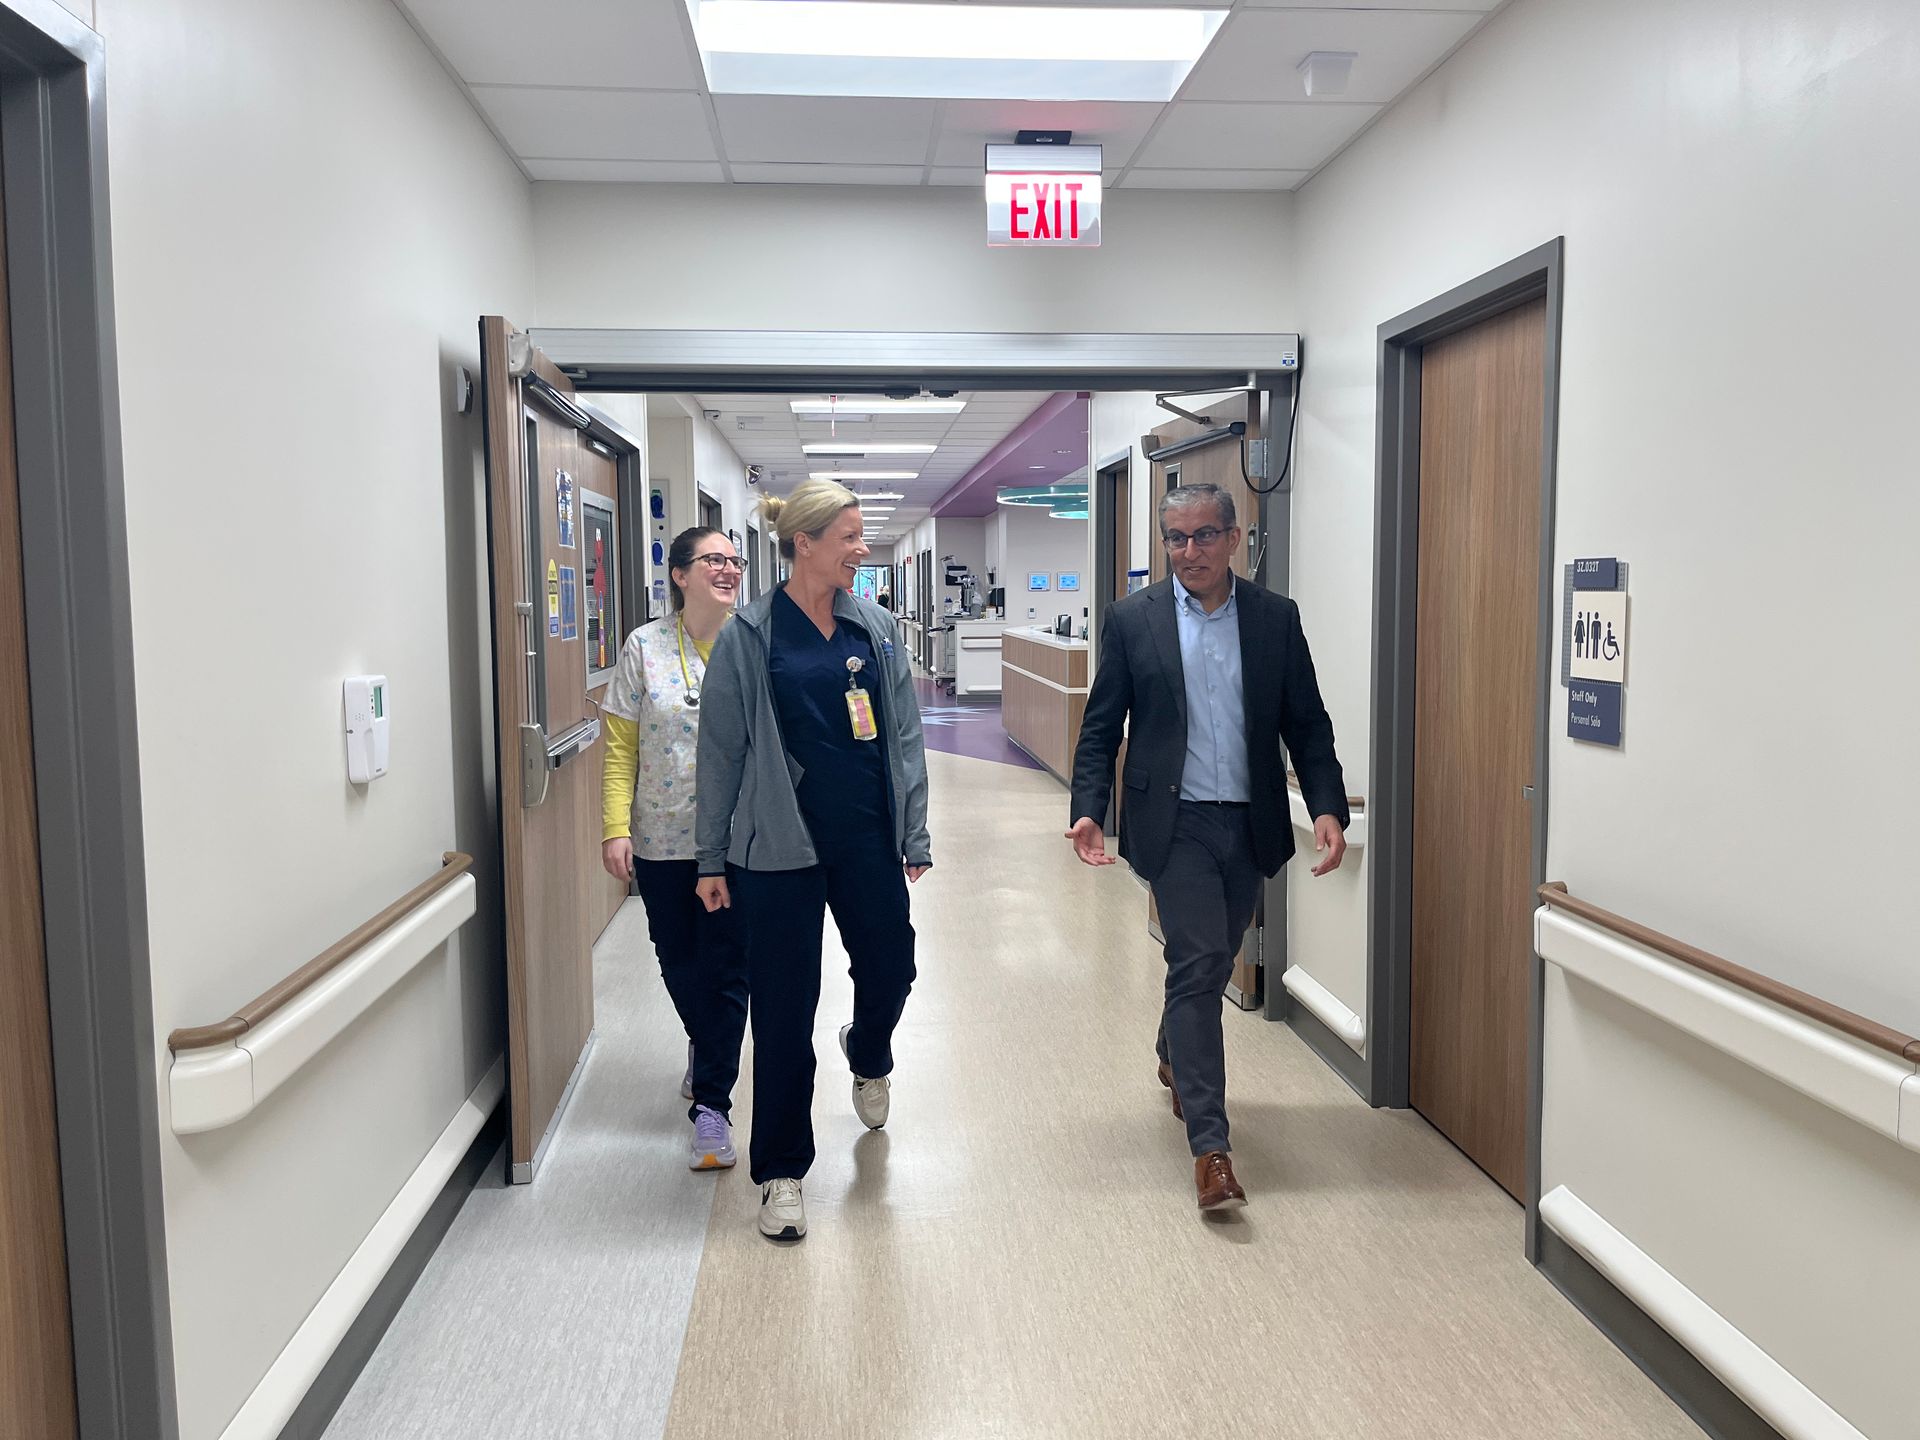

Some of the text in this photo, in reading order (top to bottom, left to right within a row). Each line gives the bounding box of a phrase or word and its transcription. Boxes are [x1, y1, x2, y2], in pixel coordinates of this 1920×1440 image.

[1010, 183, 1083, 239] EXIT
[1571, 690, 1597, 708] Staff Only
[1571, 712, 1589, 726] Personal
